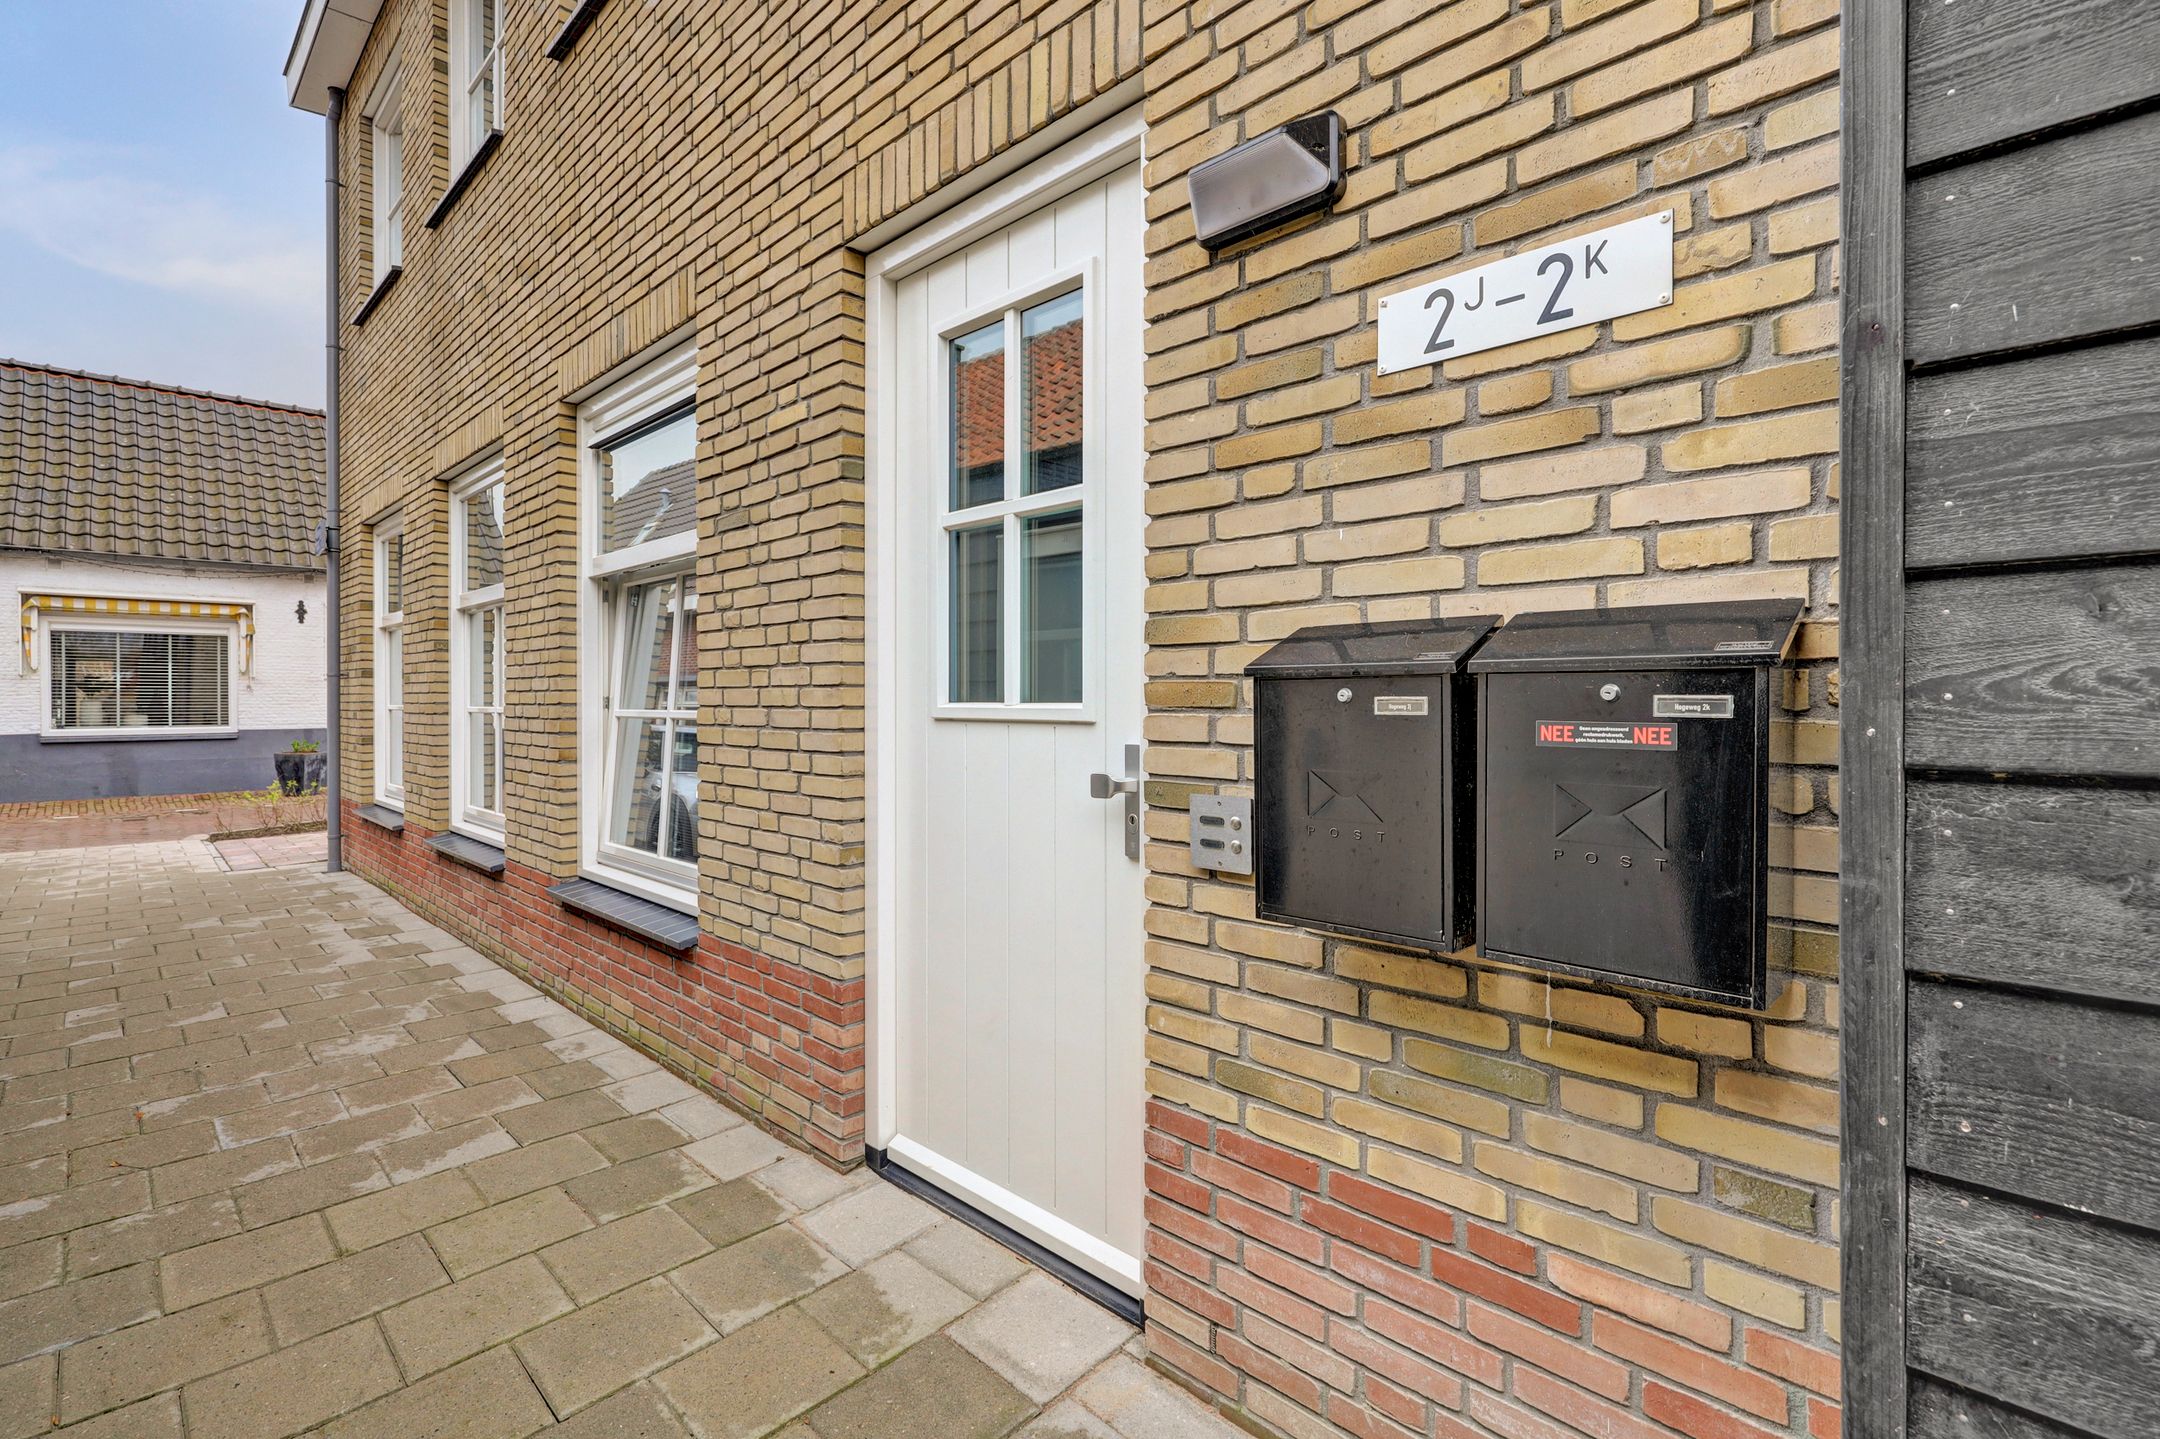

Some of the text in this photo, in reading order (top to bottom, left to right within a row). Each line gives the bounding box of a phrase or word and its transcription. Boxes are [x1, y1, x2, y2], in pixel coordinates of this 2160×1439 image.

[1674, 703, 1711, 712] Hogeweg 2k
[1540, 725, 1574, 742] NEE
[1633, 727, 1672, 745] NEE
[1306, 825, 1385, 843] POST
[1554, 848, 1667, 872] POST
